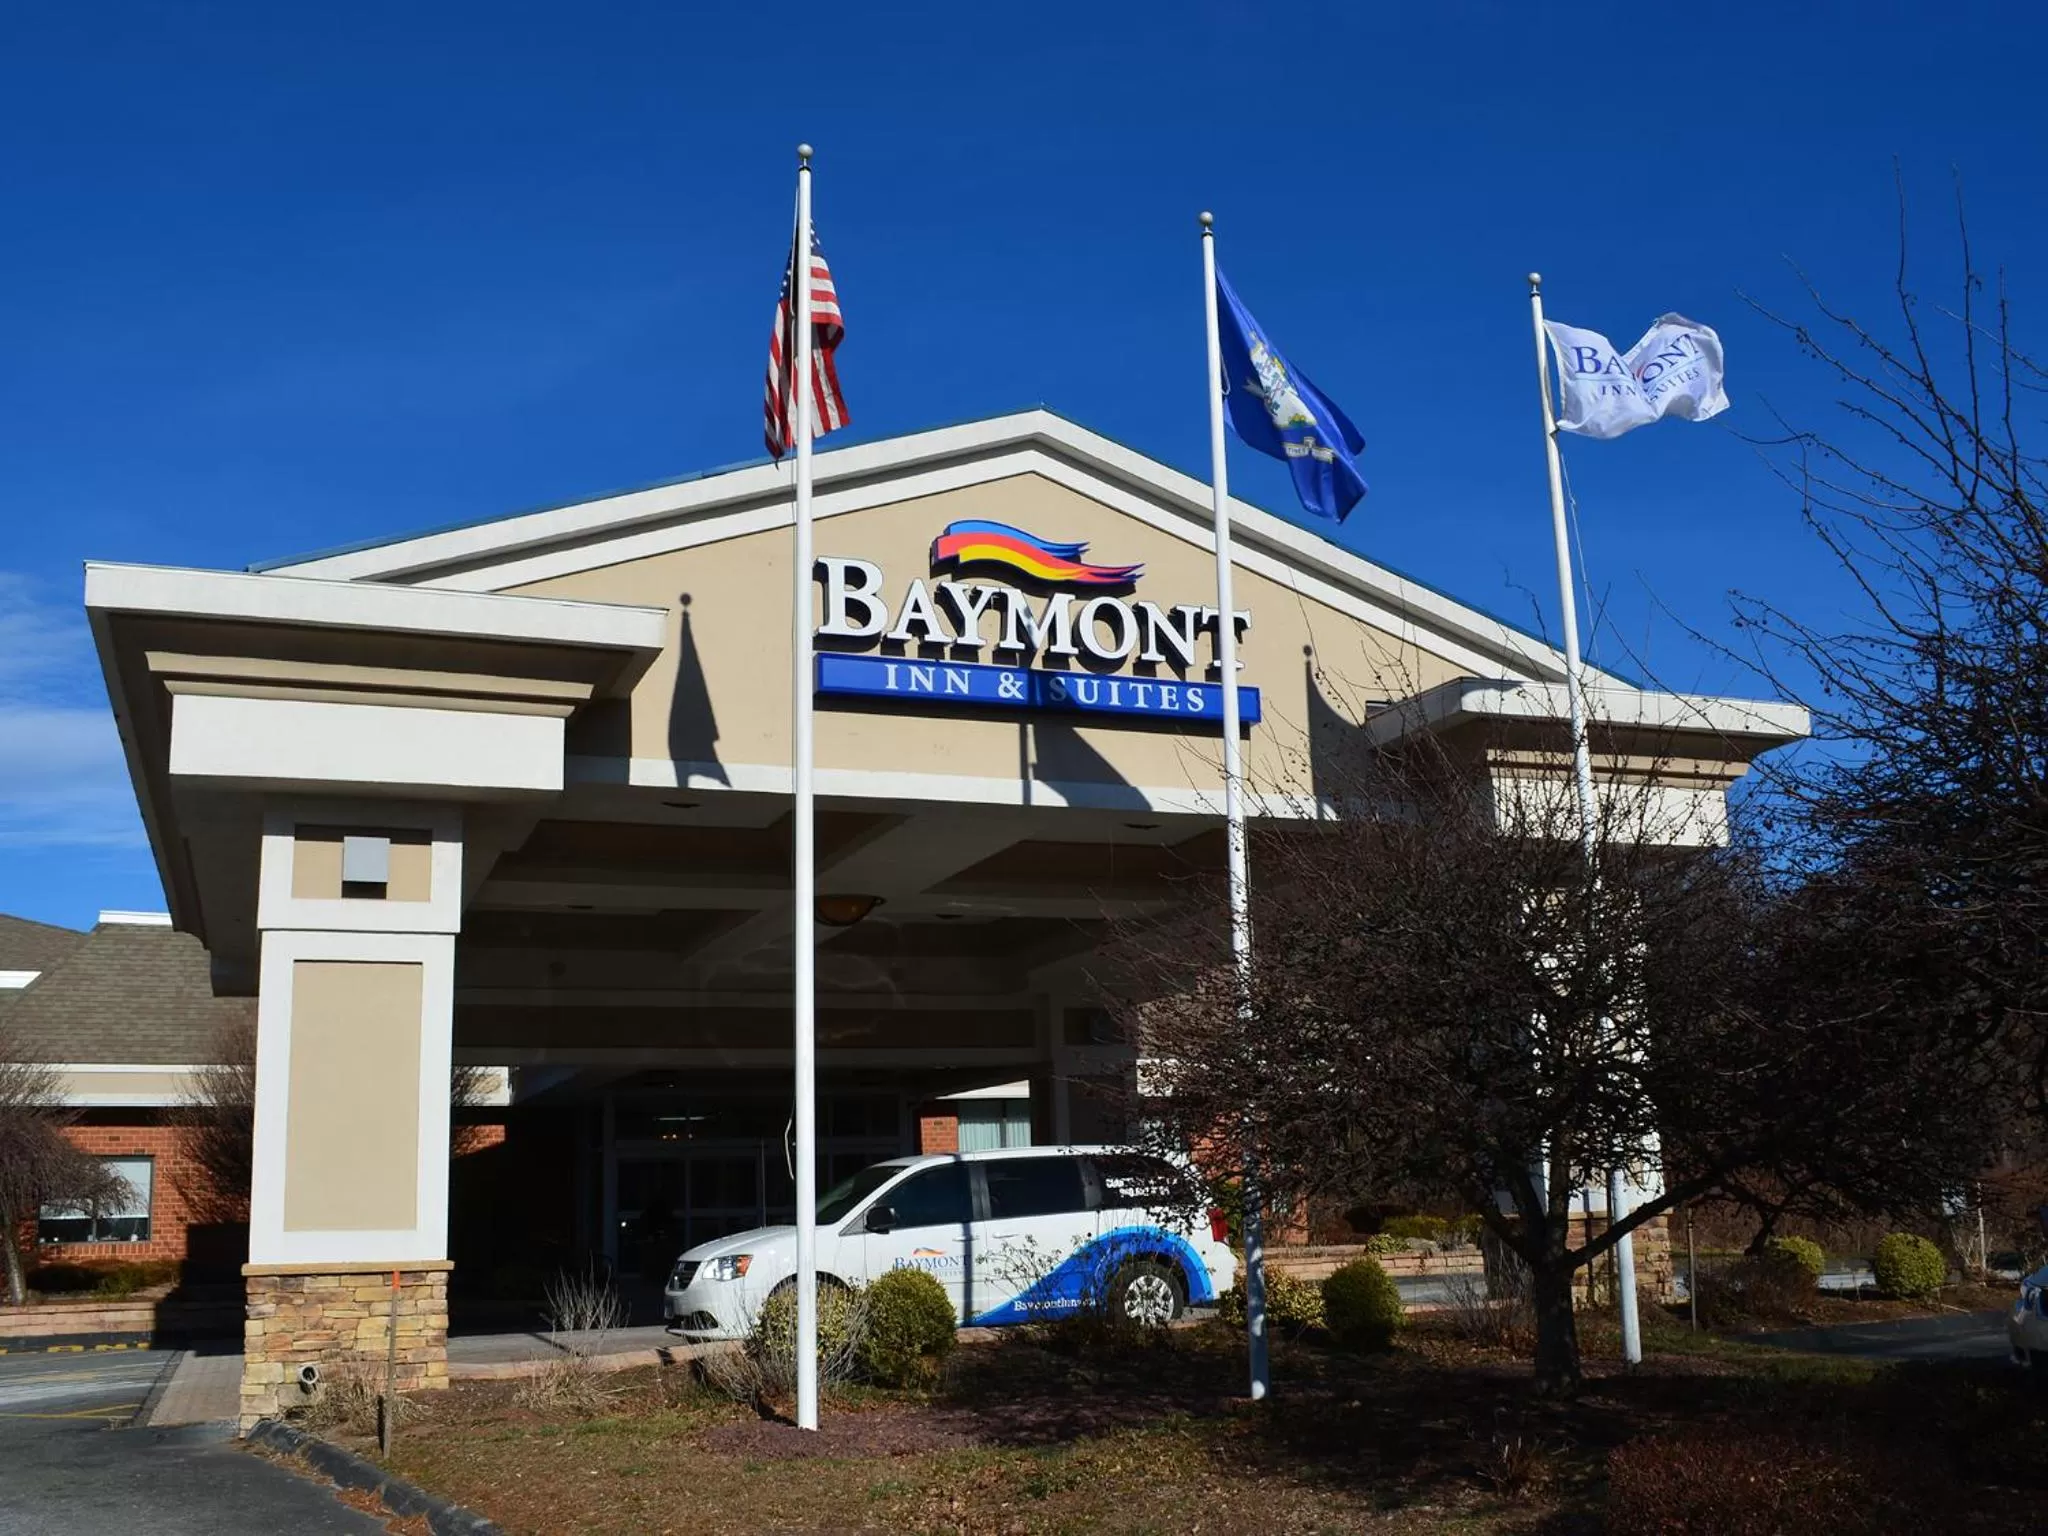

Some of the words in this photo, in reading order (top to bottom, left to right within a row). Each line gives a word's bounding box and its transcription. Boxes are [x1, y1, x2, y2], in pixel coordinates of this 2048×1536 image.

[815, 557, 1252, 670] BAYMONT
[884, 663, 971, 694] INN
[998, 671, 1025, 700] &
[1050, 676, 1206, 713] SUITES
